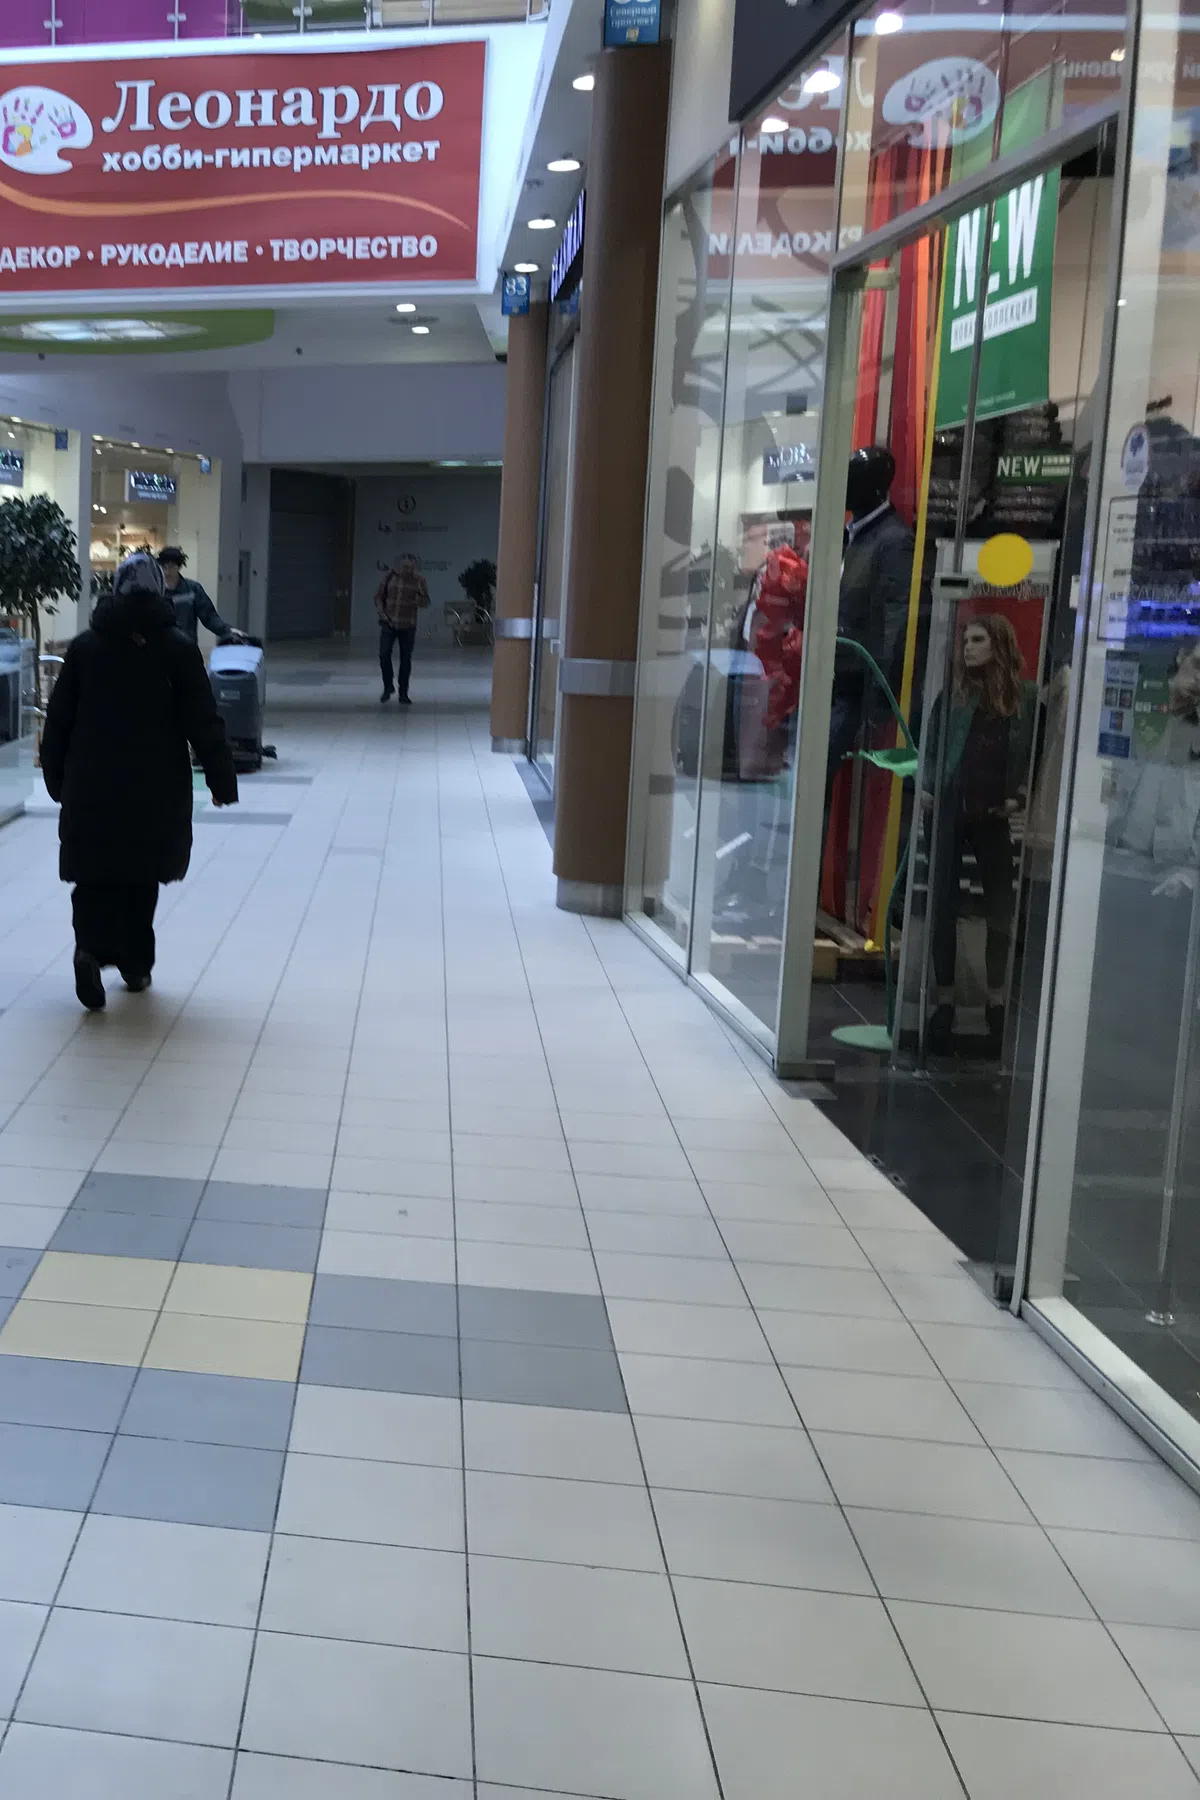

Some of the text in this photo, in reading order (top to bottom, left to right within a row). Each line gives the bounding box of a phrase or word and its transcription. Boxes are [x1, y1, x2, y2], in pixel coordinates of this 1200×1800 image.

[101, 79, 445, 140] Леонардо
[101, 140, 441, 172] хобби-гипермаркет
[101, 240, 248, 268] РУКОДЕЛИЕ
[271, 235, 438, 262] ТВОРЧЕСТВО
[997, 456, 1040, 477] NEW
